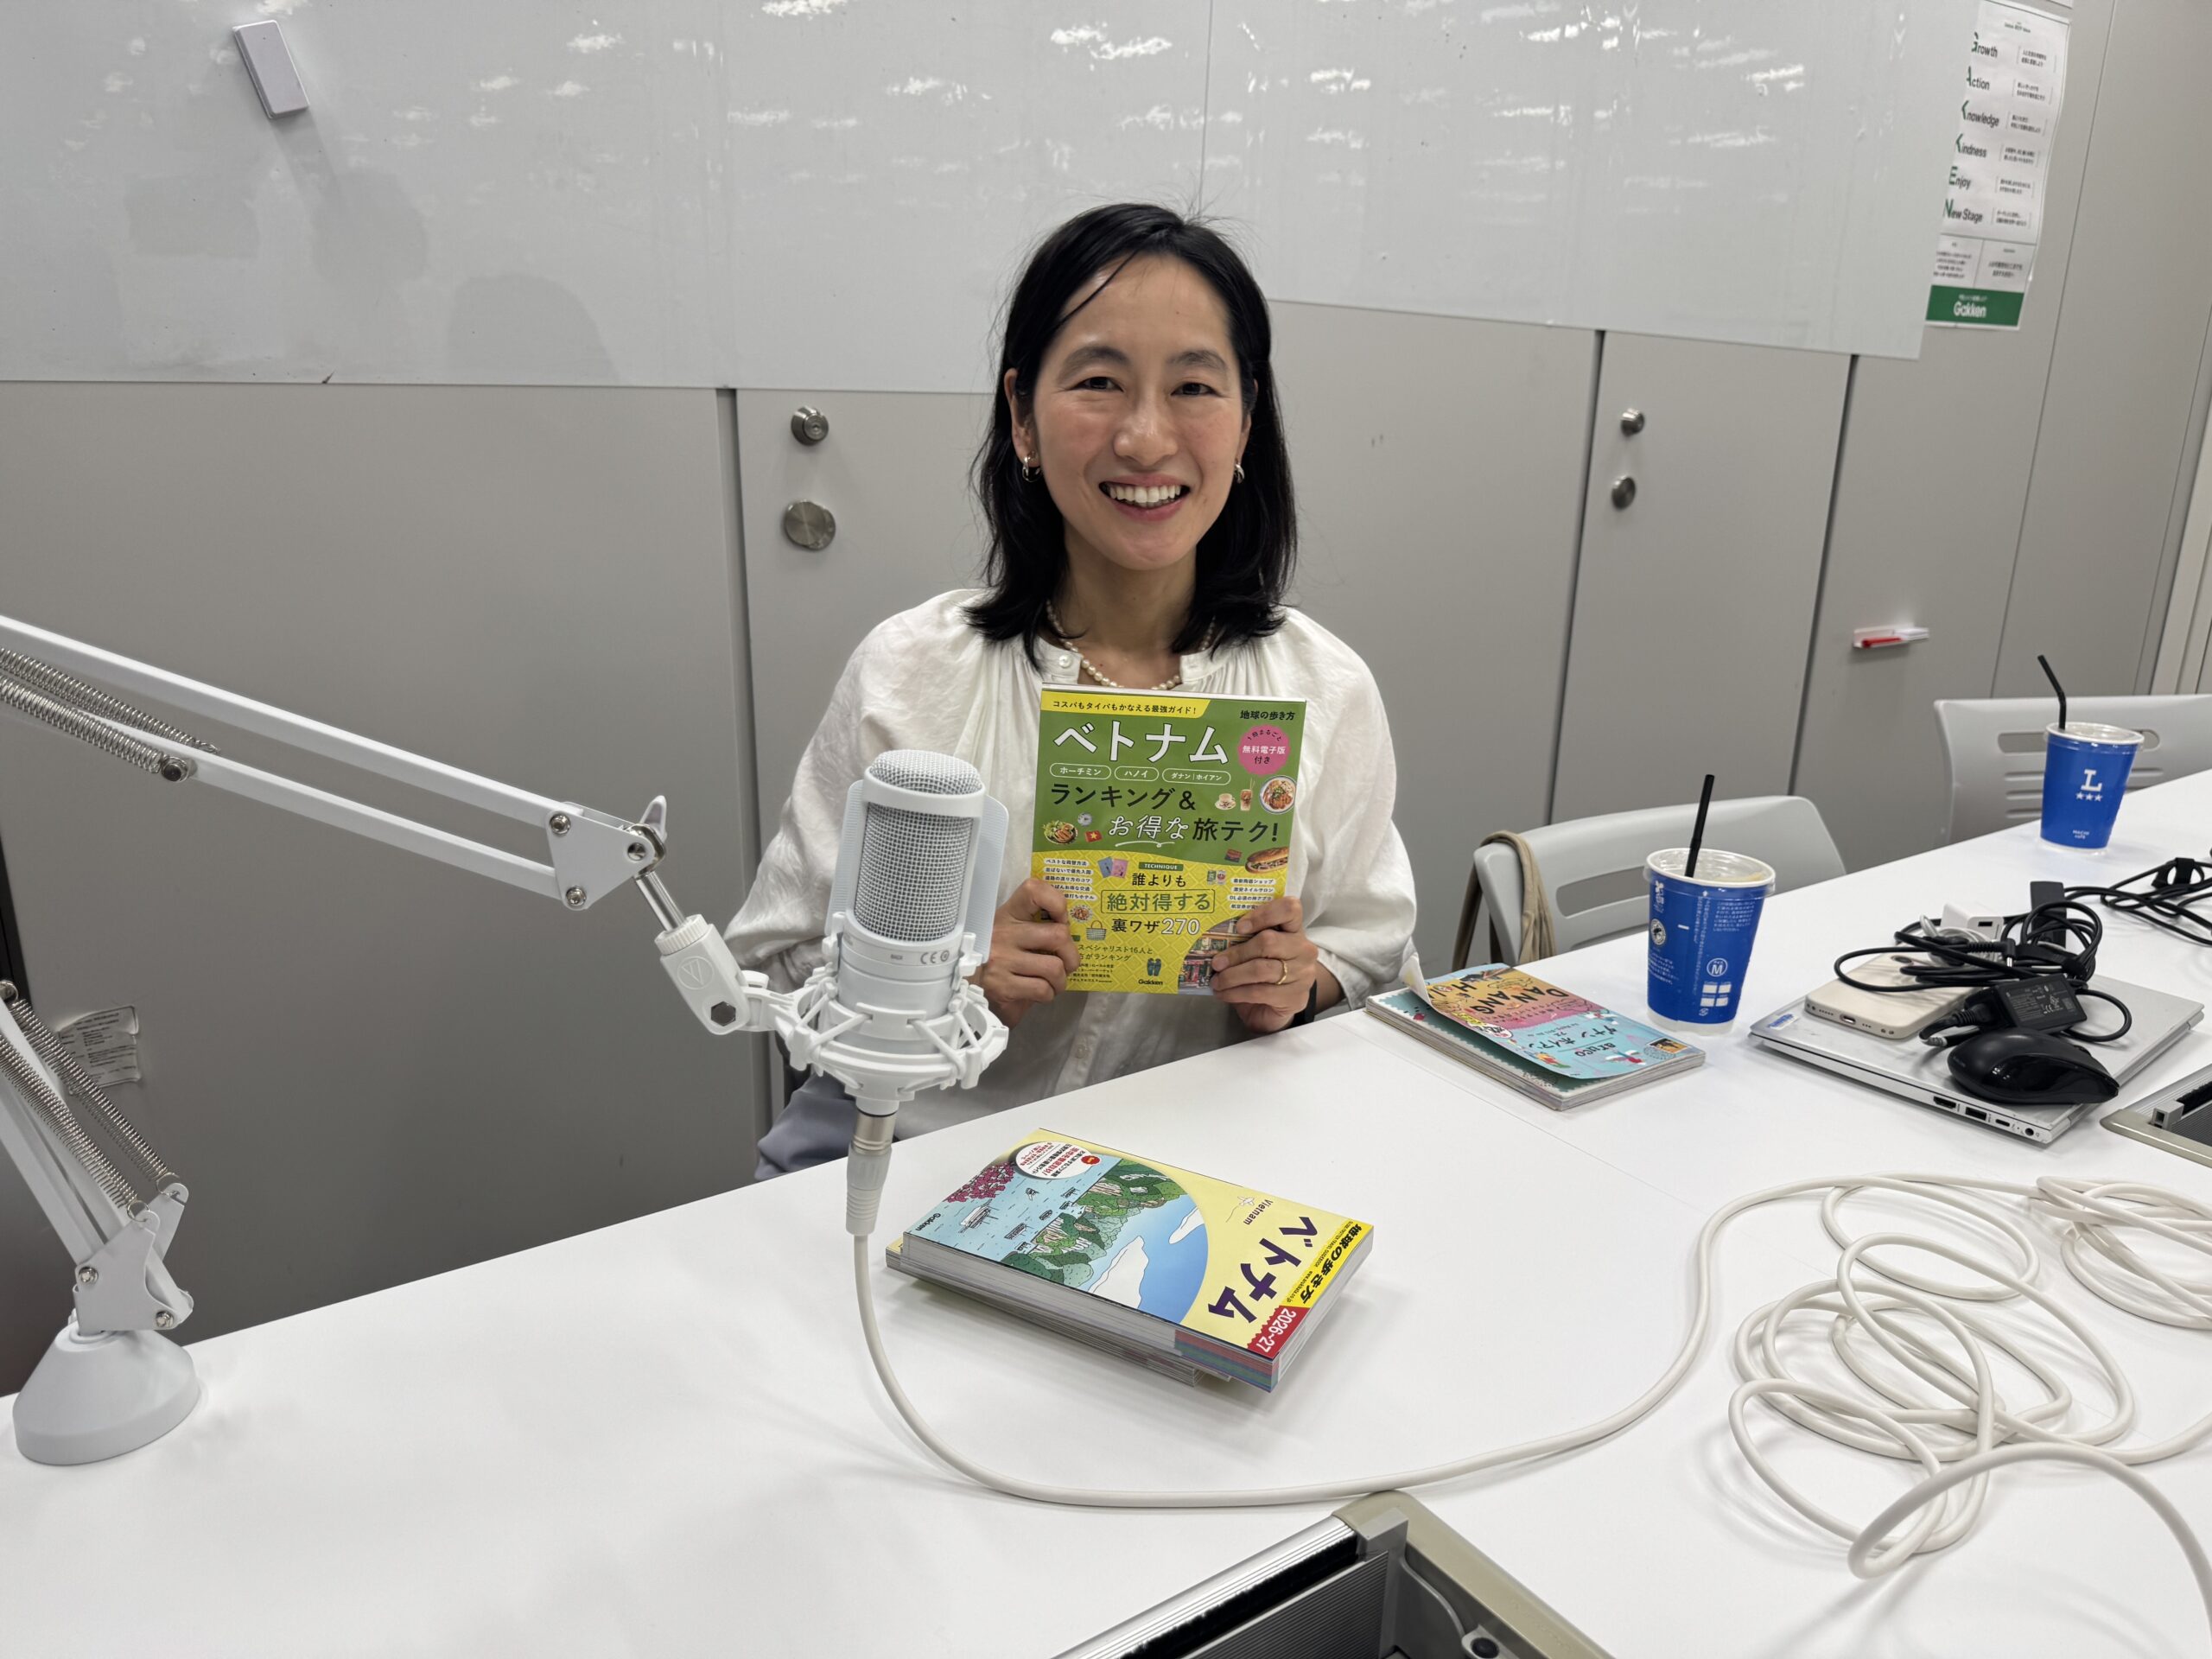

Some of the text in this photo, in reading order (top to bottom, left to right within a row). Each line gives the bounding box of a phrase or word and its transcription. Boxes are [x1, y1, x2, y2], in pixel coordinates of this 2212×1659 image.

[1949, 166, 1971, 190] Enjoy
[1962, 208, 1983, 225] Stage
[1954, 301, 1986, 318] Gakken
[1239, 709, 1296, 721] 地球の歩き方
[1052, 721, 1230, 765] ベトナム
[1242, 745, 1287, 754] 無料電子版
[1254, 756, 1271, 765] 付き
[1058, 766, 1103, 777] ホーチミン
[1123, 768, 1149, 779] ハノイ
[2081, 769, 2103, 792] L
[1131, 873, 1186, 887] 誰よりも
[1106, 893, 1211, 912] 絶対得する
[1110, 918, 1201, 936] 裏ワザ270
[1711, 964, 1723, 975] M
[1581, 1025, 1618, 1038] ダナン
[1529, 1037, 1575, 1050] ホイアン
[1574, 1042, 1617, 1057] aruco
[1243, 1198, 1274, 1226] Vietnam
[915, 1212, 942, 1231] Gakken
[1207, 1216, 1319, 1324] ベトナム
[1300, 1224, 1363, 1305] 地球の歩き方
